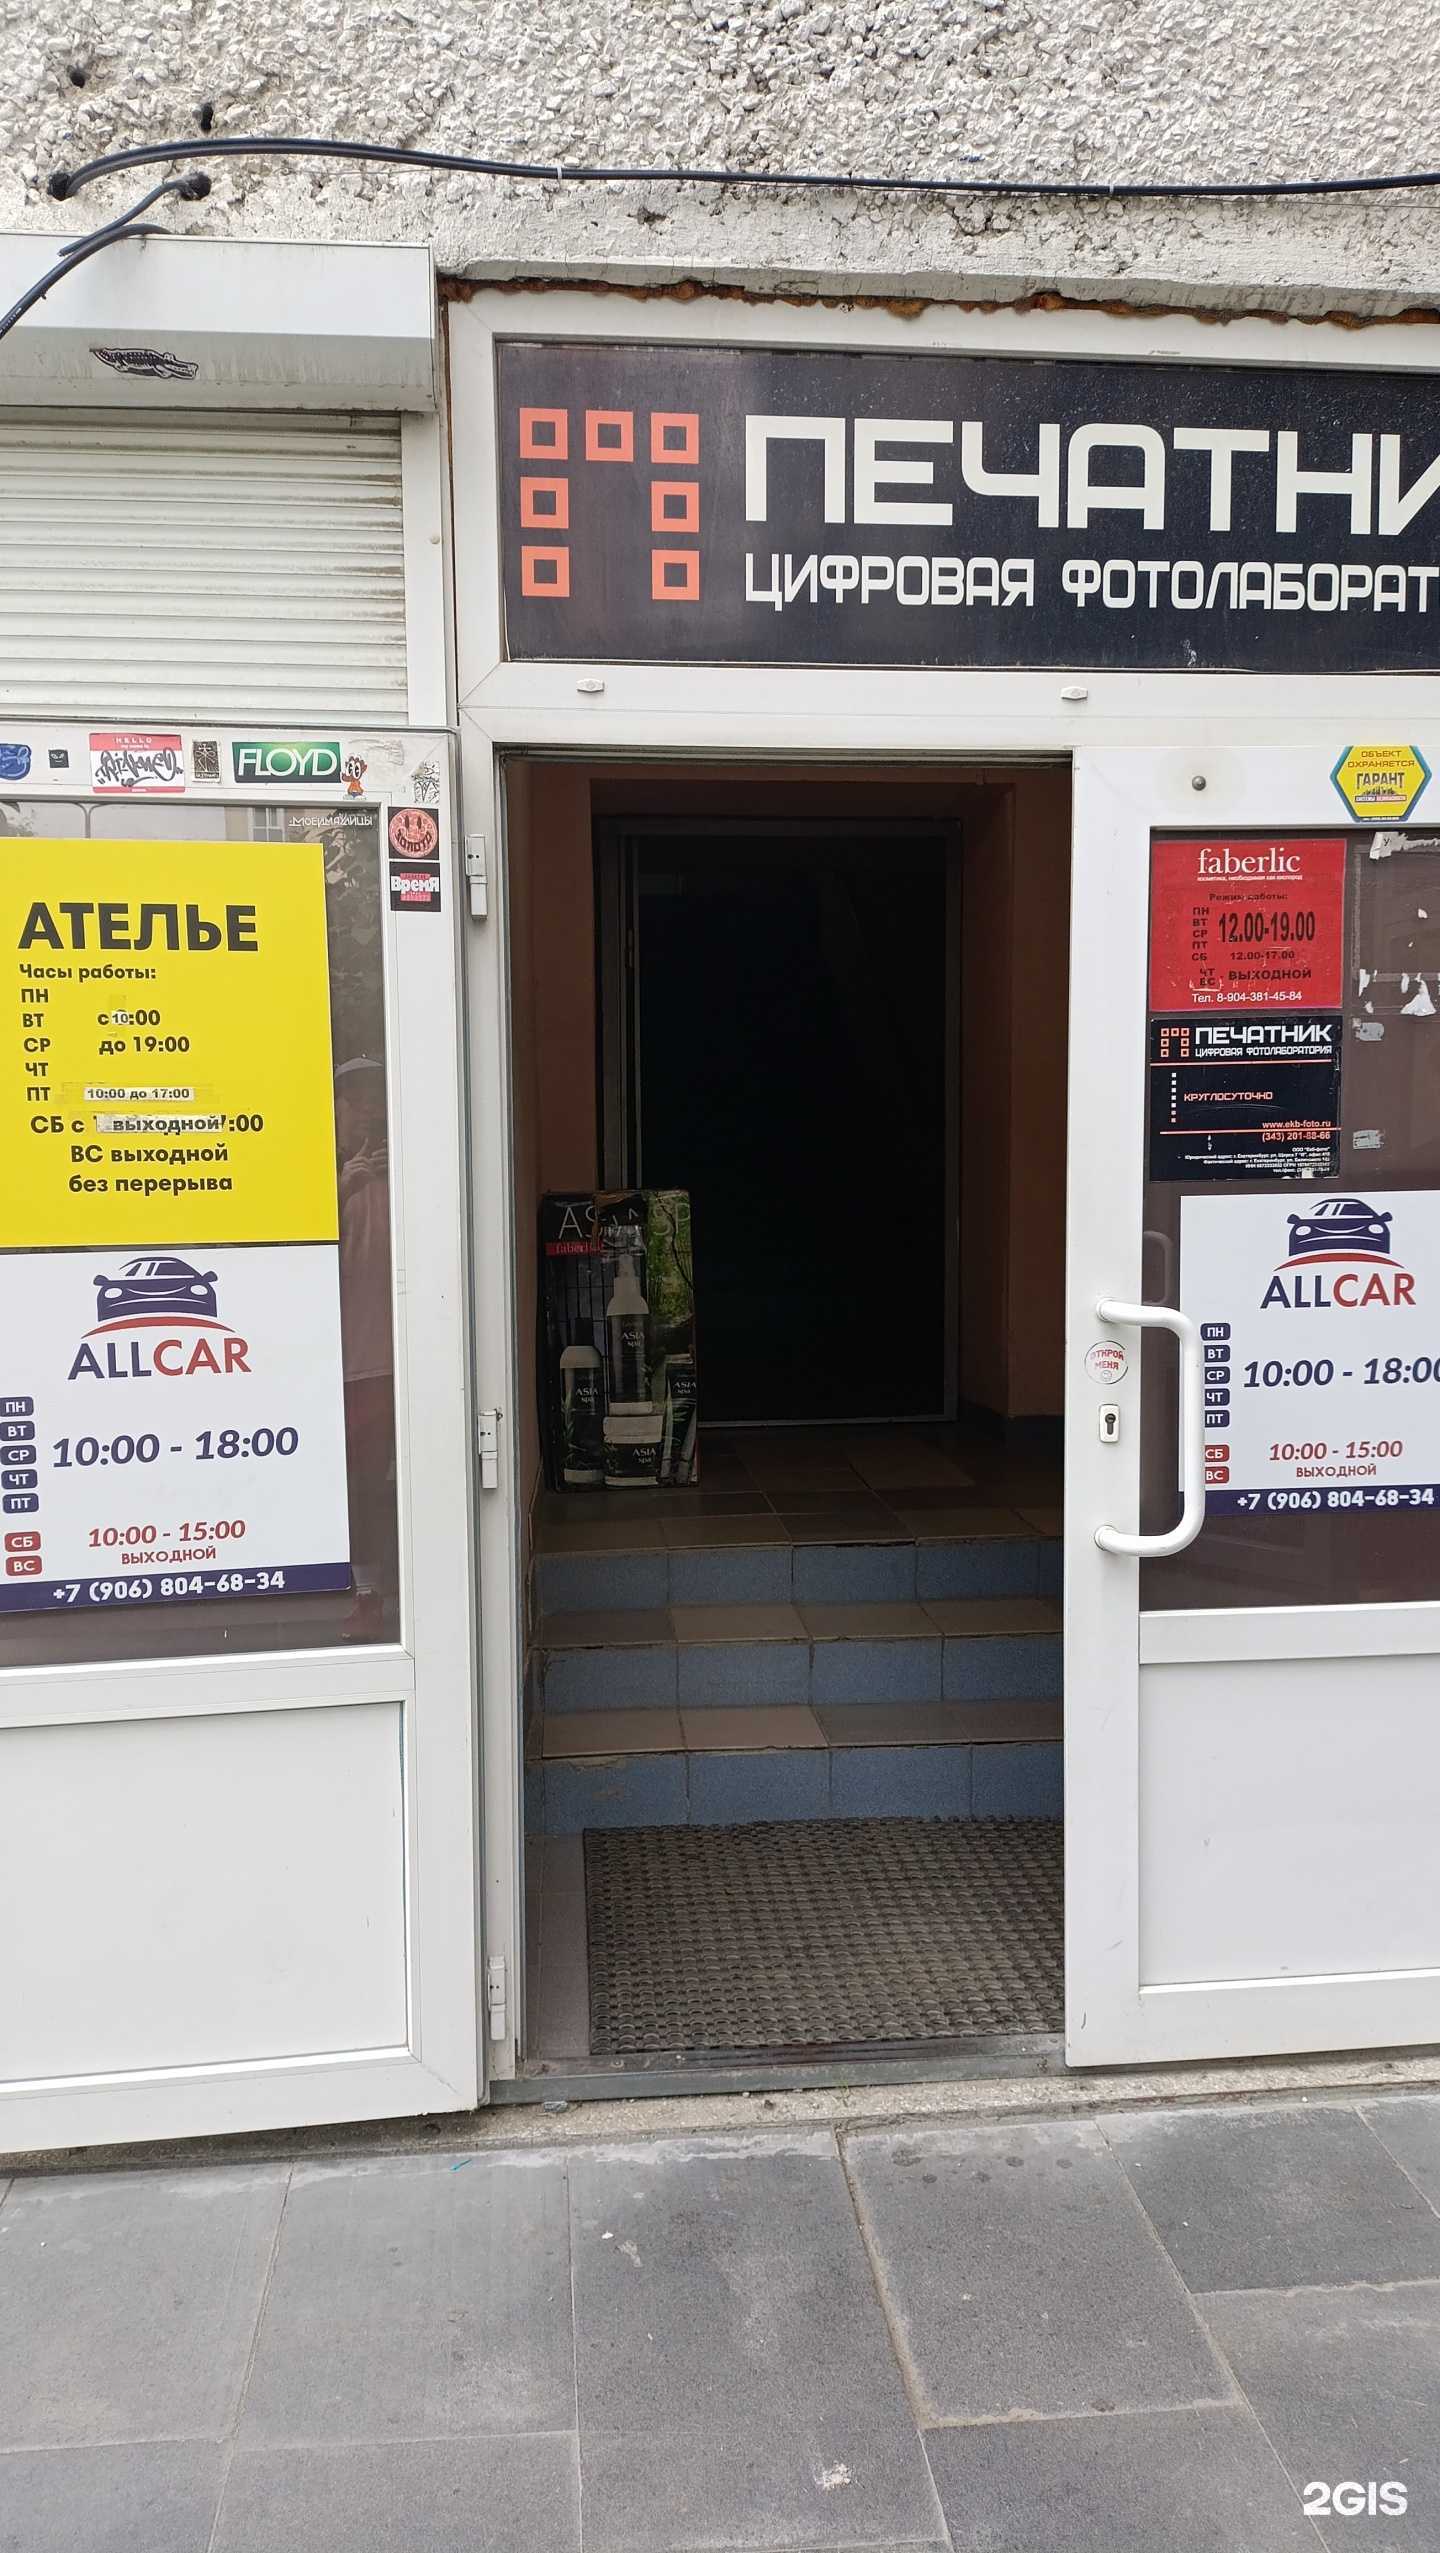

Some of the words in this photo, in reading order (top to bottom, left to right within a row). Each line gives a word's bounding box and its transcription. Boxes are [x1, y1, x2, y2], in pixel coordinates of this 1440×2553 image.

[746, 552, 1034, 612] ЦИФРОВАЯ
[1062, 559, 1440, 613] ФОТОЛАБОРАТ
[238, 747, 338, 777] FLOYD
[1347, 760, 1415, 768] ОХРАНЯЕТСЯ
[1356, 772, 1405, 789] ГАРАНТ
[1198, 848, 1301, 873] faberlic
[1192, 907, 1209, 915] ПН
[18, 902, 259, 952] АТЕЛЬЕ
[1192, 918, 1208, 926] ВТ
[1219, 911, 1315, 942] 12.00-19.00
[1193, 930, 1208, 938] СР
[1192, 941, 1208, 949] ПТ
[1230, 951, 1295, 960] 12.00-17.00
[19, 964, 72, 979] Часы
[79, 965, 156, 982] работы:
[1199, 968, 1215, 976] ЧТ
[1228, 967, 1311, 980] ВЫХОДНОЙ
[21, 988, 49, 1003] ПН
[1192, 993, 1214, 1003] Тел.
[1216, 991, 1303, 1002] 8-904-381-45-84
[22, 1013, 44, 1028] ВТ
[1195, 1024, 1332, 1045] ПЕЧАТНИК
[23, 1037, 51, 1053] СР
[99, 1040, 126, 1055] до
[133, 1036, 190, 1052] 19:00
[1195, 1047, 1243, 1058] ЦИФРОВАЯ
[1246, 1046, 1332, 1056] ФОТОЛАБОРАТОРИЯ
[25, 1062, 49, 1077] ЧТ
[26, 1086, 51, 1101] ПТ
[87, 1088, 126, 1098] 10:00
[130, 1090, 147, 1100] до
[152, 1088, 190, 1098] 17:00
[1183, 1091, 1273, 1101] КРУГЛОСУТОЧНО
[30, 1115, 64, 1133] СБ
[71, 1120, 85, 1133] с
[113, 1116, 219, 1133] выходной
[1262, 1120, 1331, 1128] www.ekb-foto.ru
[1262, 1132, 1285, 1142] (343)
[71, 1145, 103, 1163] ВС
[111, 1143, 228, 1164] выходной
[69, 1175, 108, 1192] без
[115, 1175, 233, 1196] перерыва
[1260, 1273, 1416, 1309] ALLCAR
[1207, 1326, 1224, 1337] ПН
[67, 1337, 252, 1381] ALLCAR
[1207, 1348, 1224, 1359] ВТ
[1206, 1370, 1225, 1381] СР
[1243, 1358, 1334, 1388] 10:00
[1206, 1392, 1223, 1402] ЧТ
[5, 1401, 26, 1413] ПН
[1206, 1413, 1223, 1424] ПТ
[7, 1425, 27, 1437] ВТ
[52, 1434, 160, 1468] 10:00
[195, 1427, 299, 1460] 18:00
[632, 1447, 656, 1456] ASIA
[1205, 1448, 1224, 1459] СБ
[1269, 1442, 1327, 1461] 10:00
[1345, 1440, 1403, 1459] 15:00
[8, 1449, 29, 1461] СР
[1206, 1470, 1224, 1481] ВС
[1296, 1463, 1376, 1478] ВЫХОДНОЙ
[9, 1473, 29, 1485] ЧТ
[10, 1497, 31, 1509] ПТ
[1237, 1493, 1260, 1510] +7
[1267, 1490, 1321, 1511] (906)
[1327, 1488, 1435, 1507] 804-68-34
[88, 1525, 157, 1548] 10:00
[179, 1519, 246, 1543] 15:00
[11, 1536, 33, 1548] СБ
[121, 1546, 217, 1565] ВЫХОДНОЙ
[13, 1560, 35, 1572] ВС
[53, 1584, 80, 1603] +7
[89, 1580, 152, 1601] (906)
[160, 1570, 285, 1597] 804-68-34
